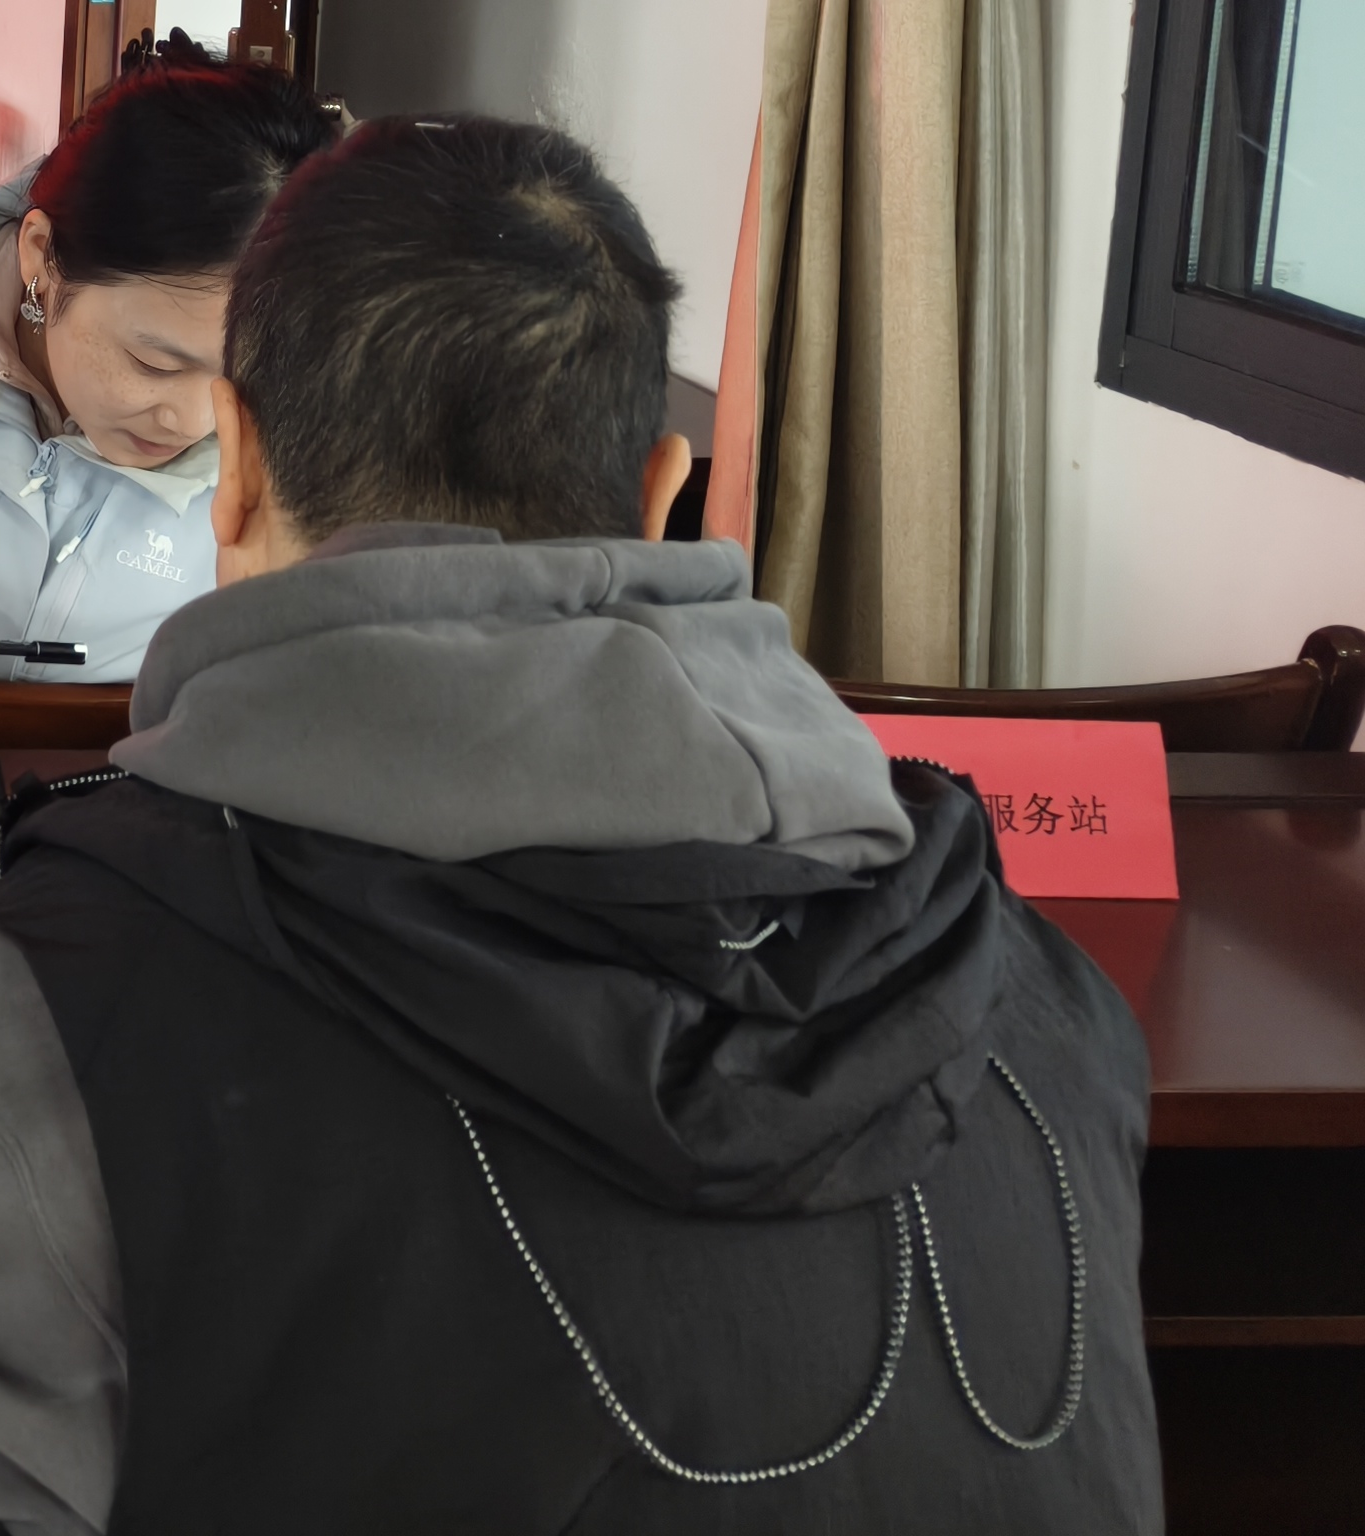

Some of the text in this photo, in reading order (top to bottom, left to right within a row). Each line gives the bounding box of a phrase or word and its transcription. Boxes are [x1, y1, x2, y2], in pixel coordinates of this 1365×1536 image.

[115, 549, 189, 584] CAMEL
[982, 792, 1109, 836] 服务站
